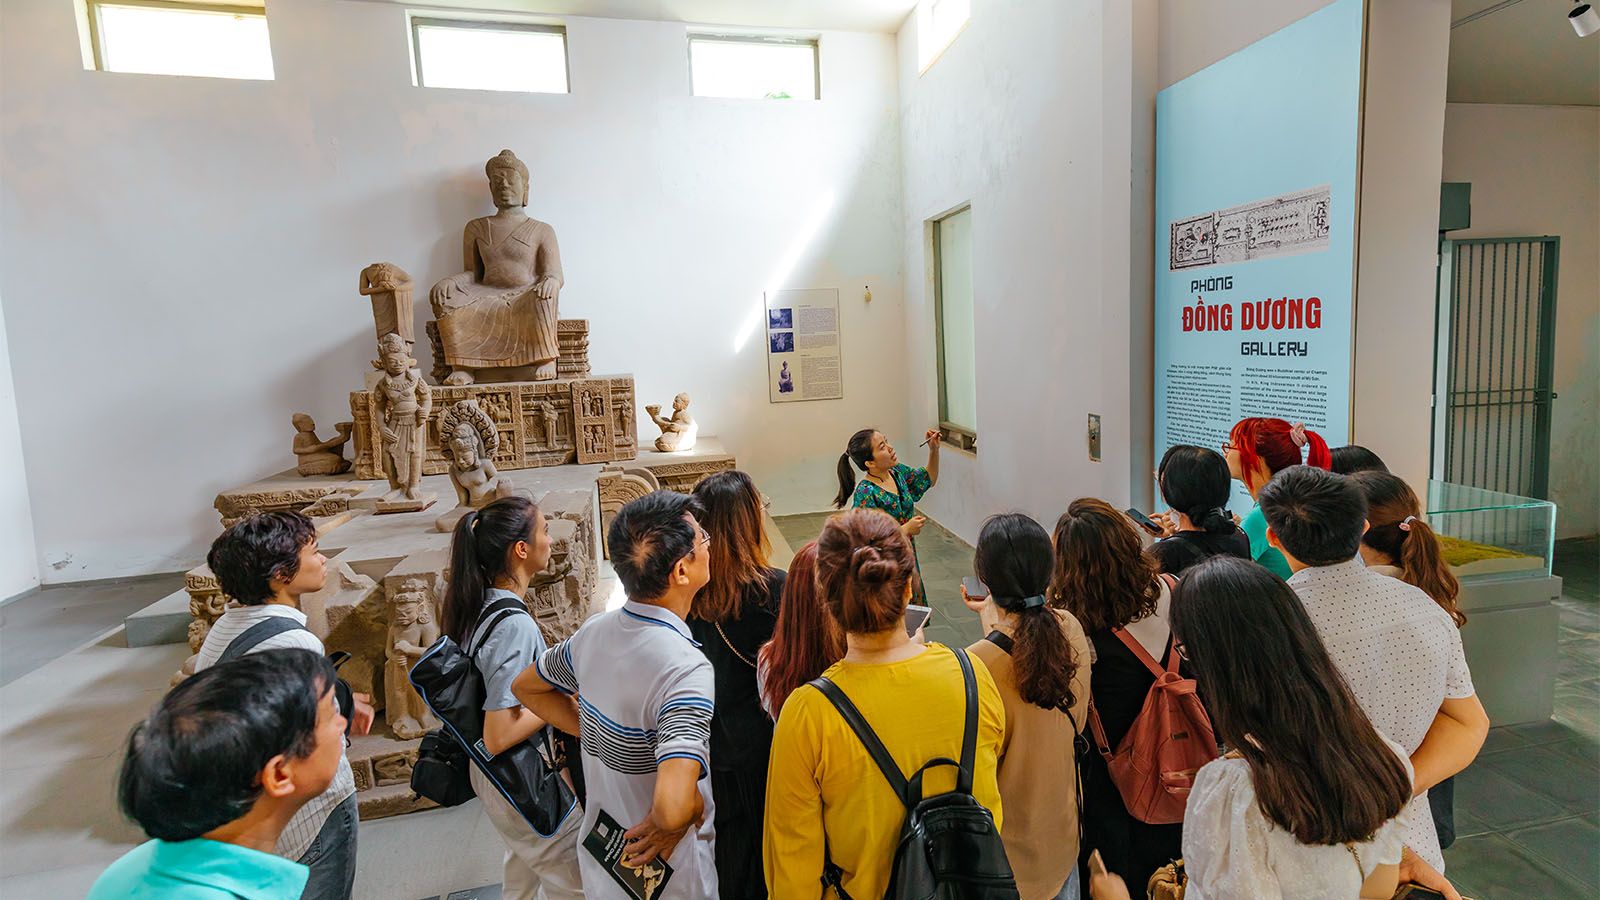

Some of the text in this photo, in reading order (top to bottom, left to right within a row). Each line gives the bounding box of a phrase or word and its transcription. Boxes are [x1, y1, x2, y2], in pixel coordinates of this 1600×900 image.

[1191, 276, 1233, 293] PHÒNG
[1182, 296, 1322, 332] ĐỒNG DƯƠNG
[1240, 342, 1308, 356] GALLERY
